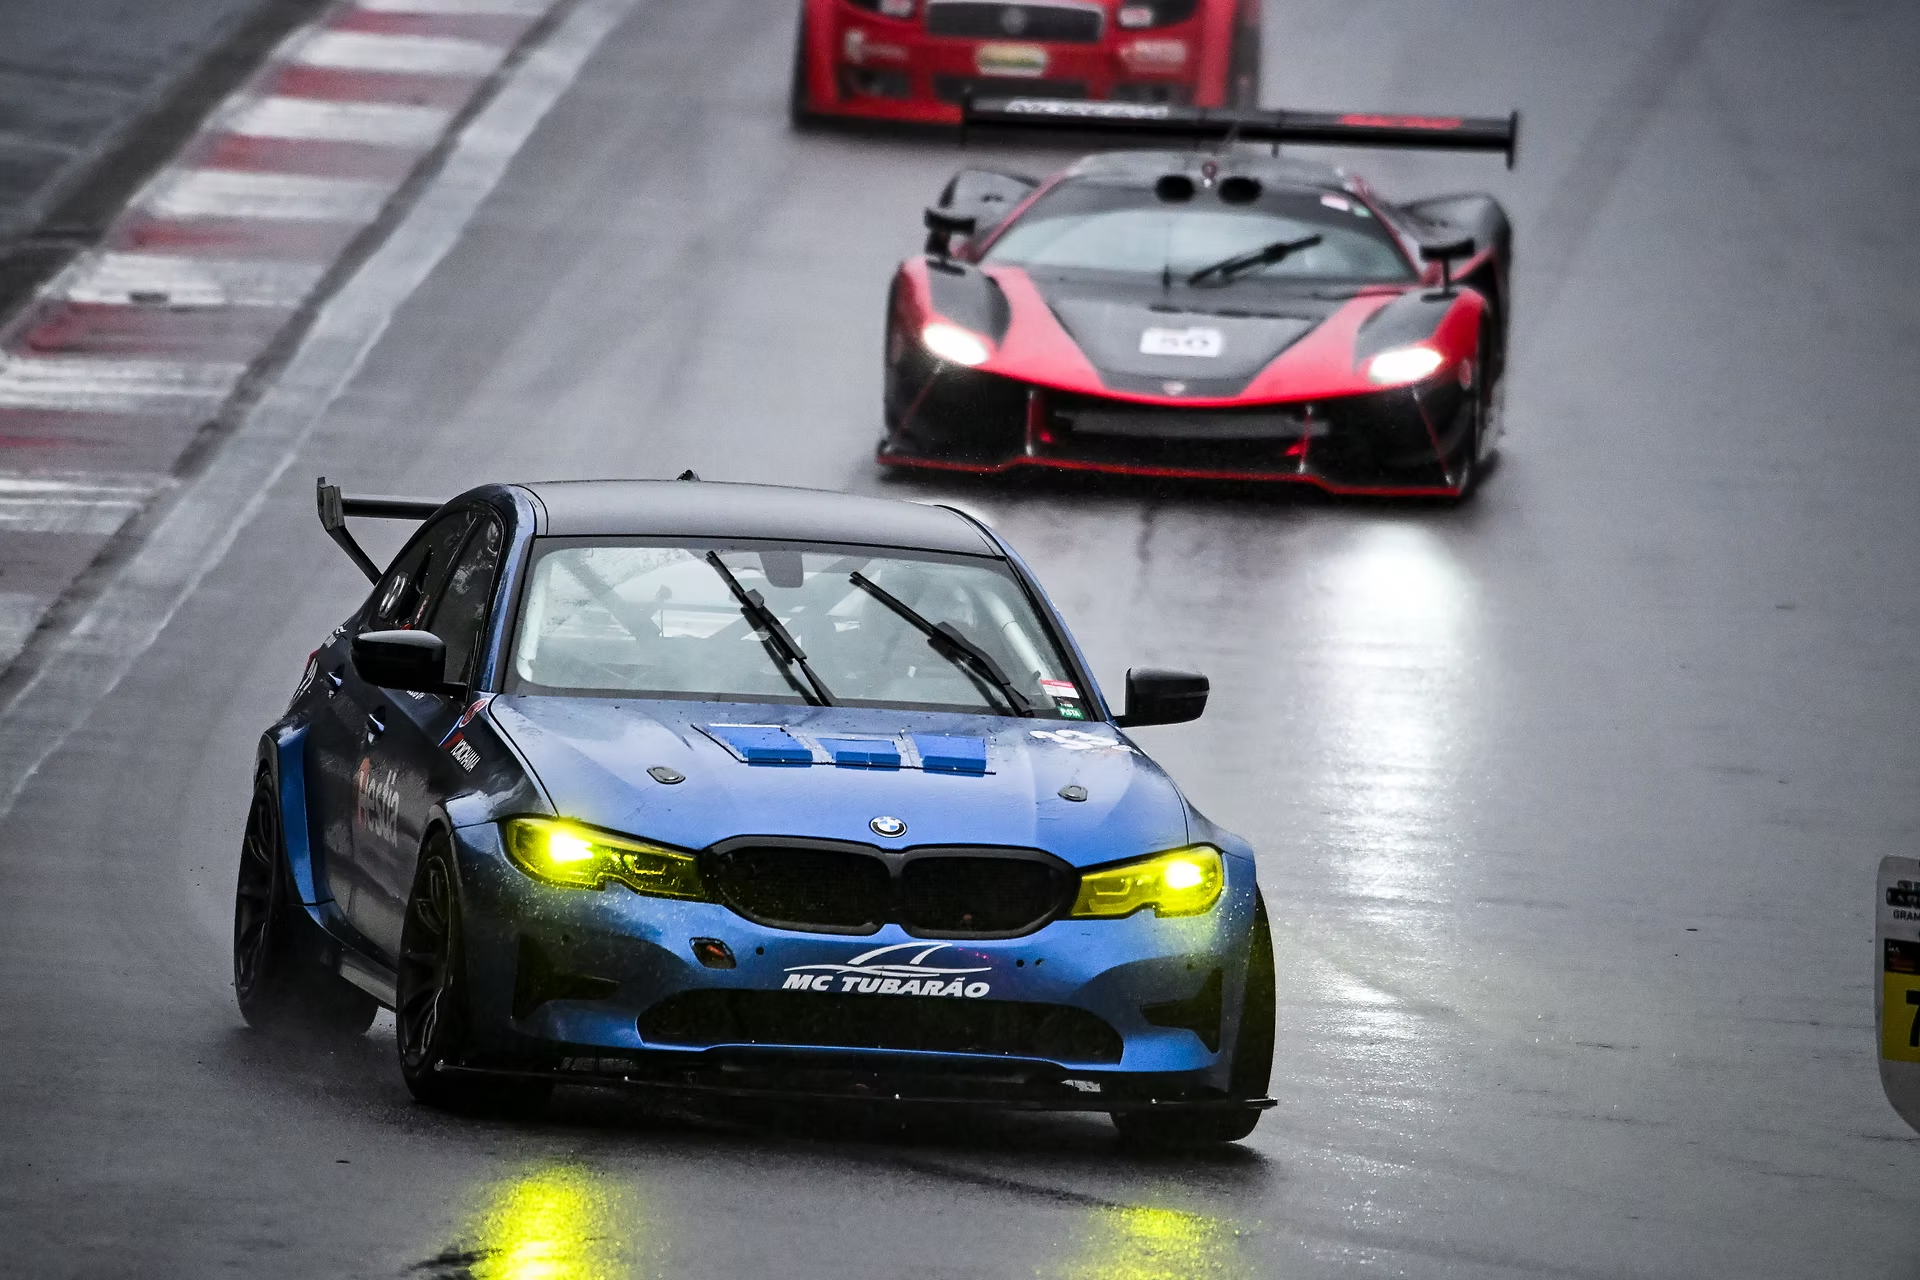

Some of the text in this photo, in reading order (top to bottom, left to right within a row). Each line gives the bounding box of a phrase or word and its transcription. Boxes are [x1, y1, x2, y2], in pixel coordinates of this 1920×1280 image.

[450, 738, 482, 773] YOKOHAMA
[782, 974, 990, 998] MC TUBARÃO
